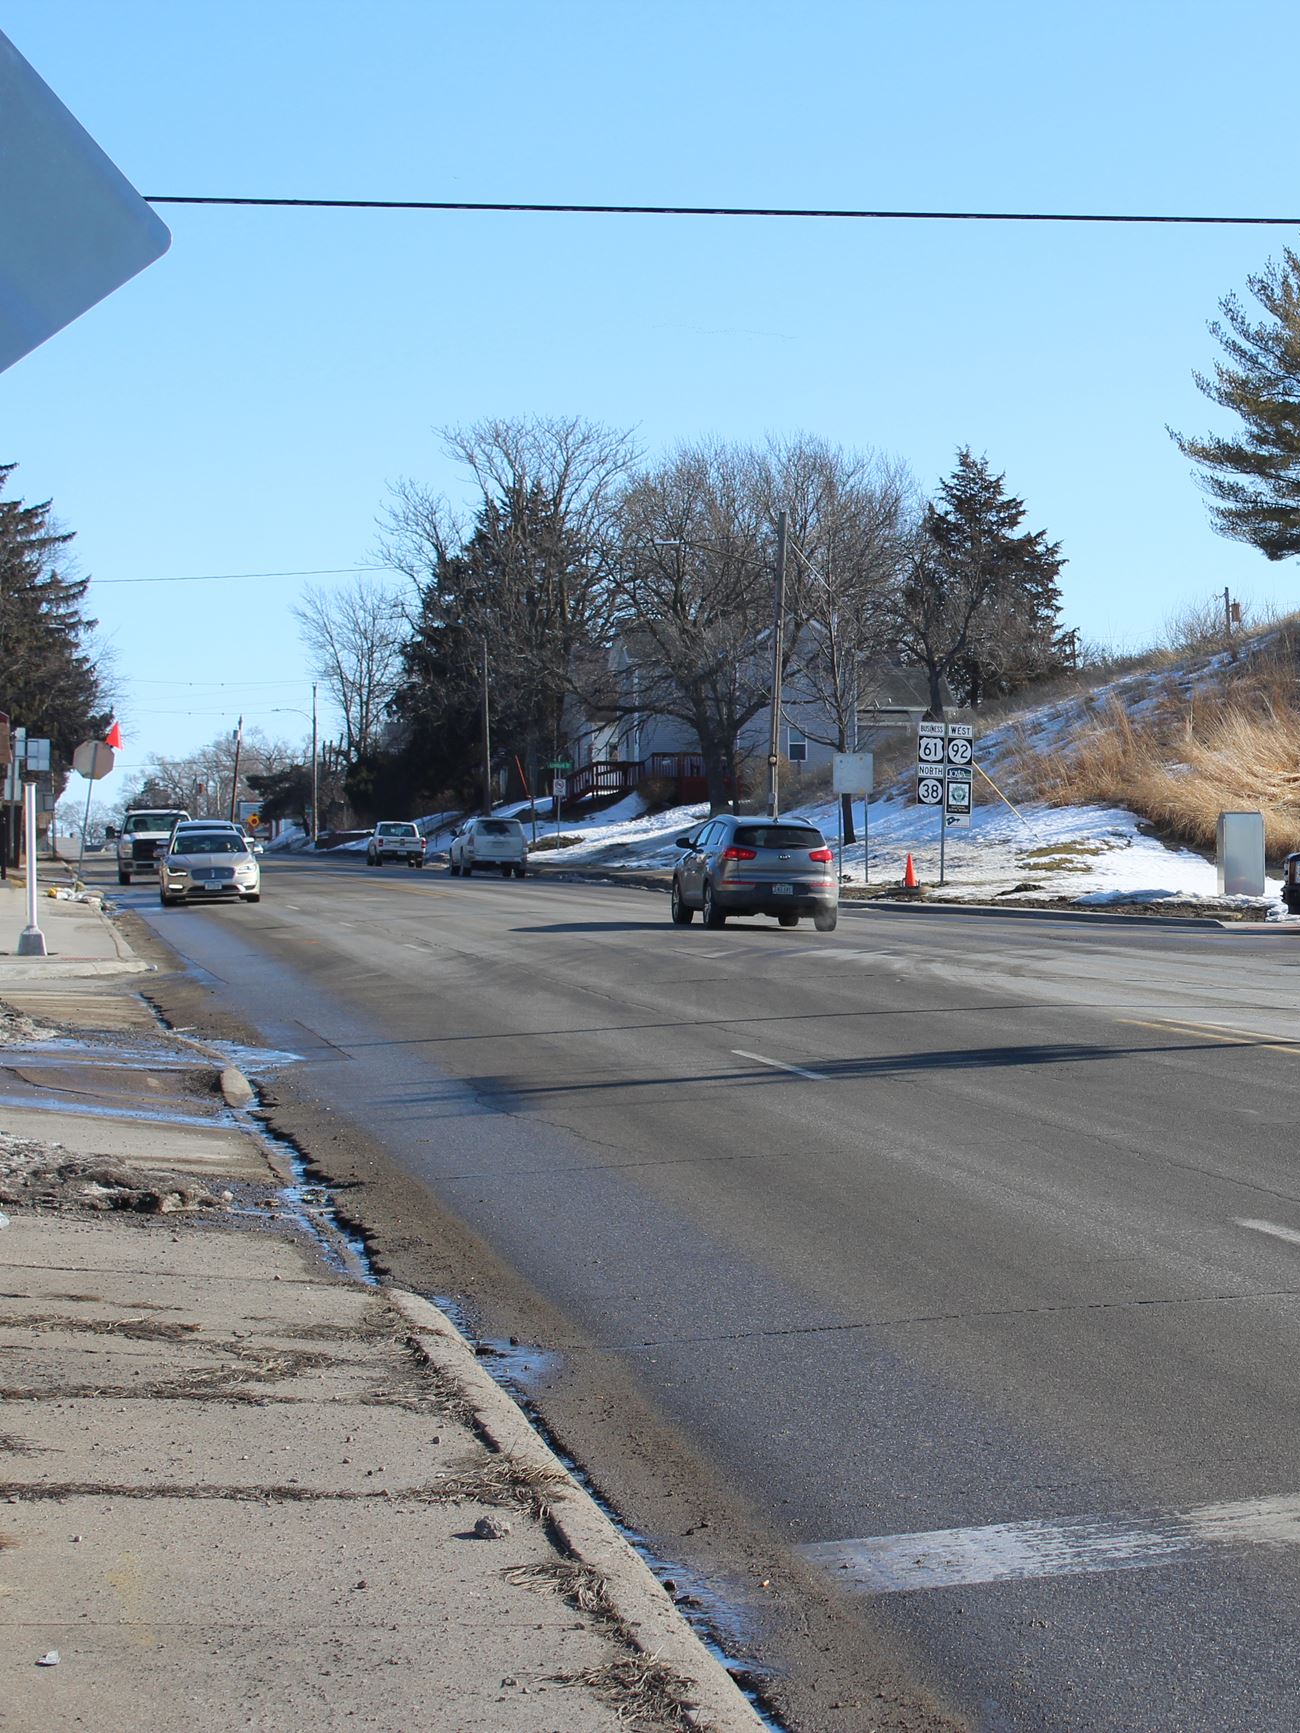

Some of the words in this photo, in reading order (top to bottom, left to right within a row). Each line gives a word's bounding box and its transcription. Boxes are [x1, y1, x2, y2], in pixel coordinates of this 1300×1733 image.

[920, 724, 944, 733] BUSINESS
[950, 726, 971, 736] WEST
[923, 742, 938, 757] 61
[951, 743, 969, 759] 92
[919, 766, 943, 776] NORTH
[921, 783, 939, 799] 38
